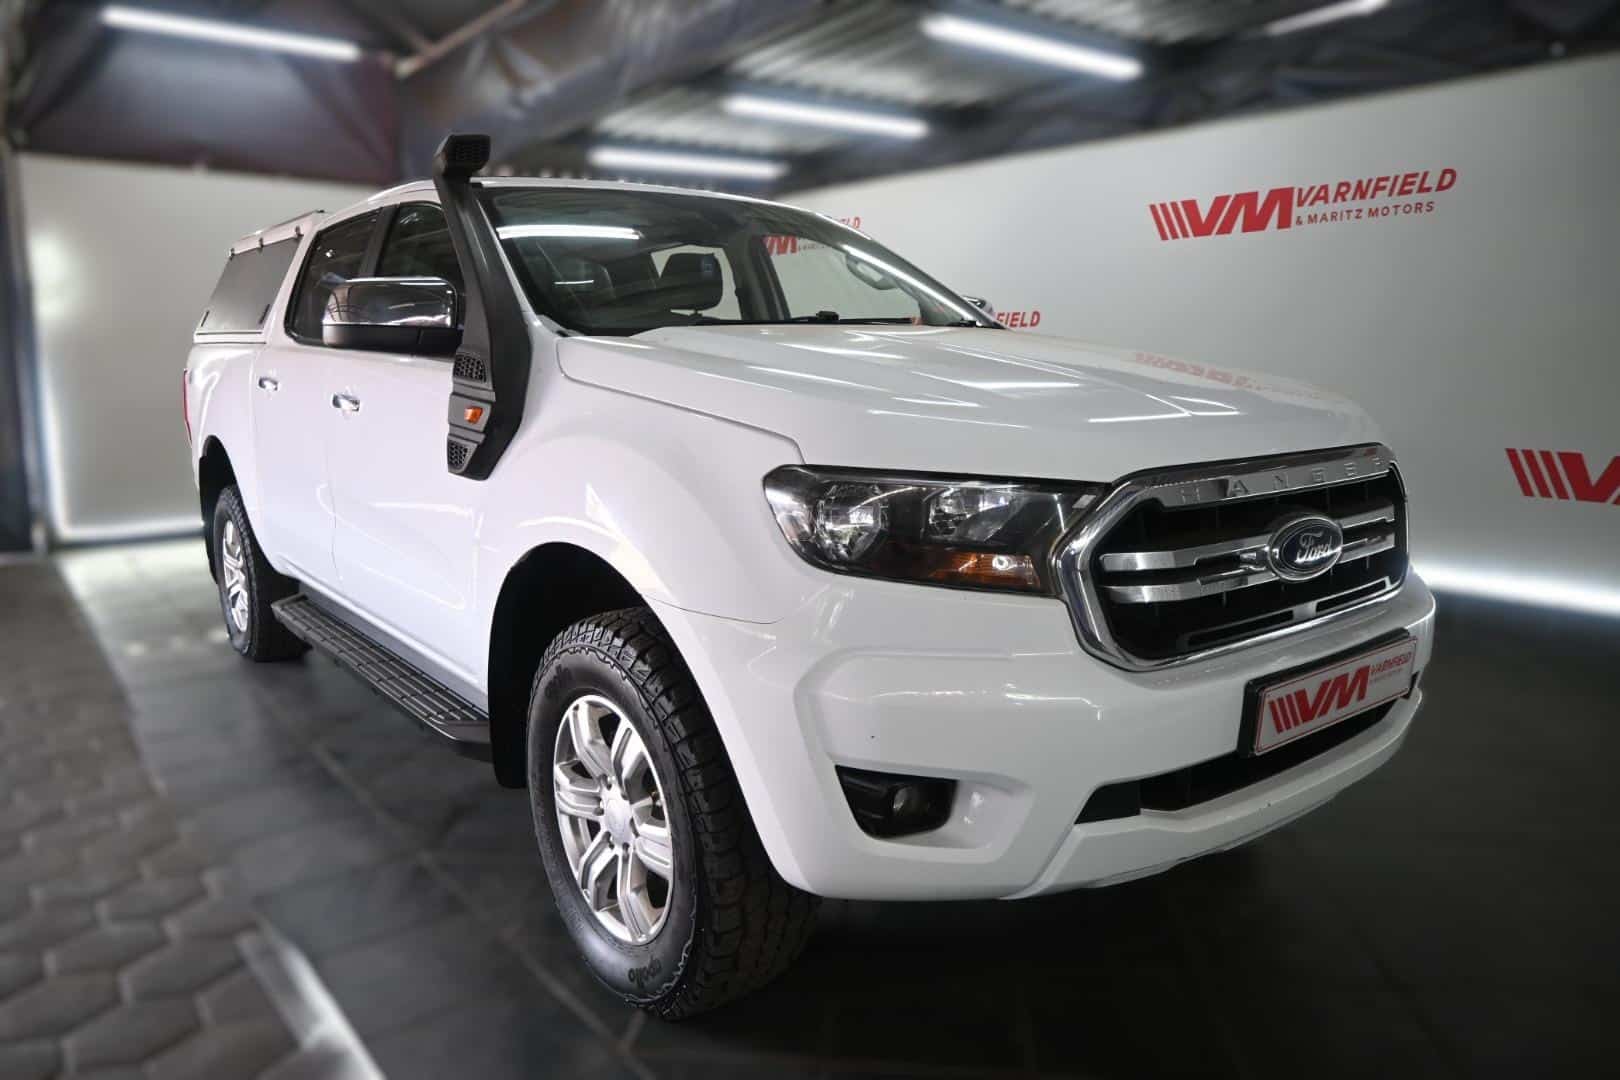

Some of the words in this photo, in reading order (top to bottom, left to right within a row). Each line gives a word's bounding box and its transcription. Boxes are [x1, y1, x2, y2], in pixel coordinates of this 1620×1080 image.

[1296, 168, 1457, 207] VARNFIELD
[1181, 186, 1294, 238] VM
[1296, 218, 1303, 226] &
[1307, 209, 1363, 225] MARITZ
[1367, 200, 1435, 219] MOTORS
[996, 310, 1041, 328] FIELD
[1556, 451, 1620, 506] V
[1295, 532, 1333, 563] Ford
[1294, 665, 1371, 723] VM
